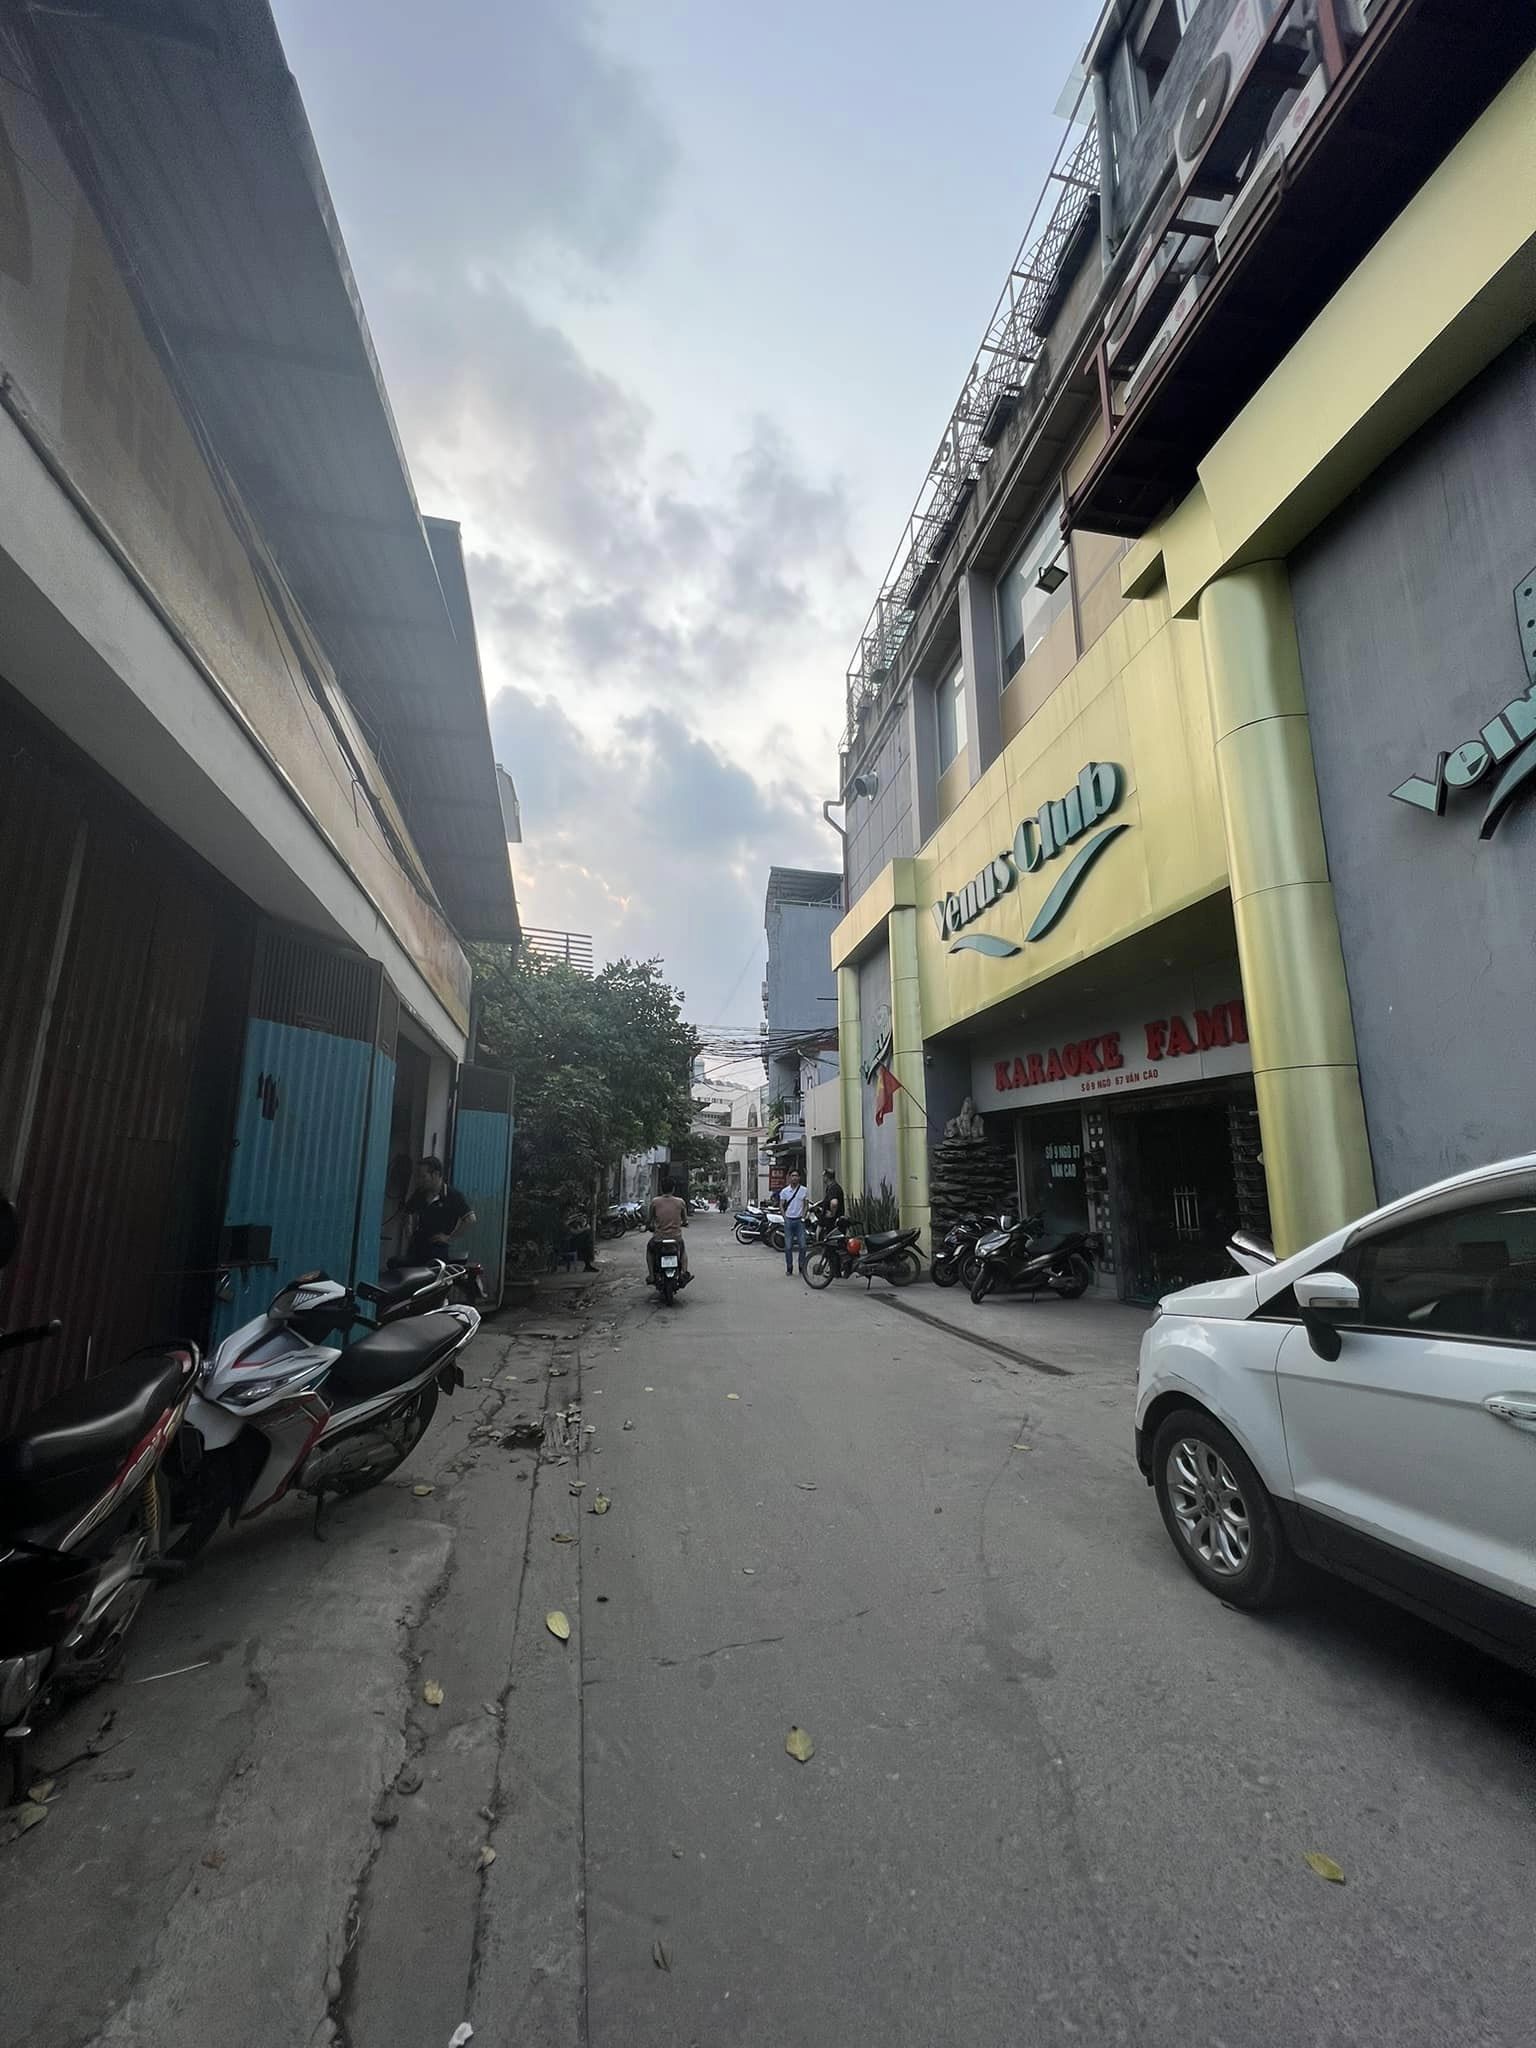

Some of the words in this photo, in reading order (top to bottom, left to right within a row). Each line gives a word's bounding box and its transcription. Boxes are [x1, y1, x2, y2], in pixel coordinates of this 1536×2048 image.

[1388, 682, 1536, 816] Ven
[931, 851, 1017, 941] Venus
[1013, 762, 1125, 872] Club
[994, 1032, 1124, 1092] KARAOKE
